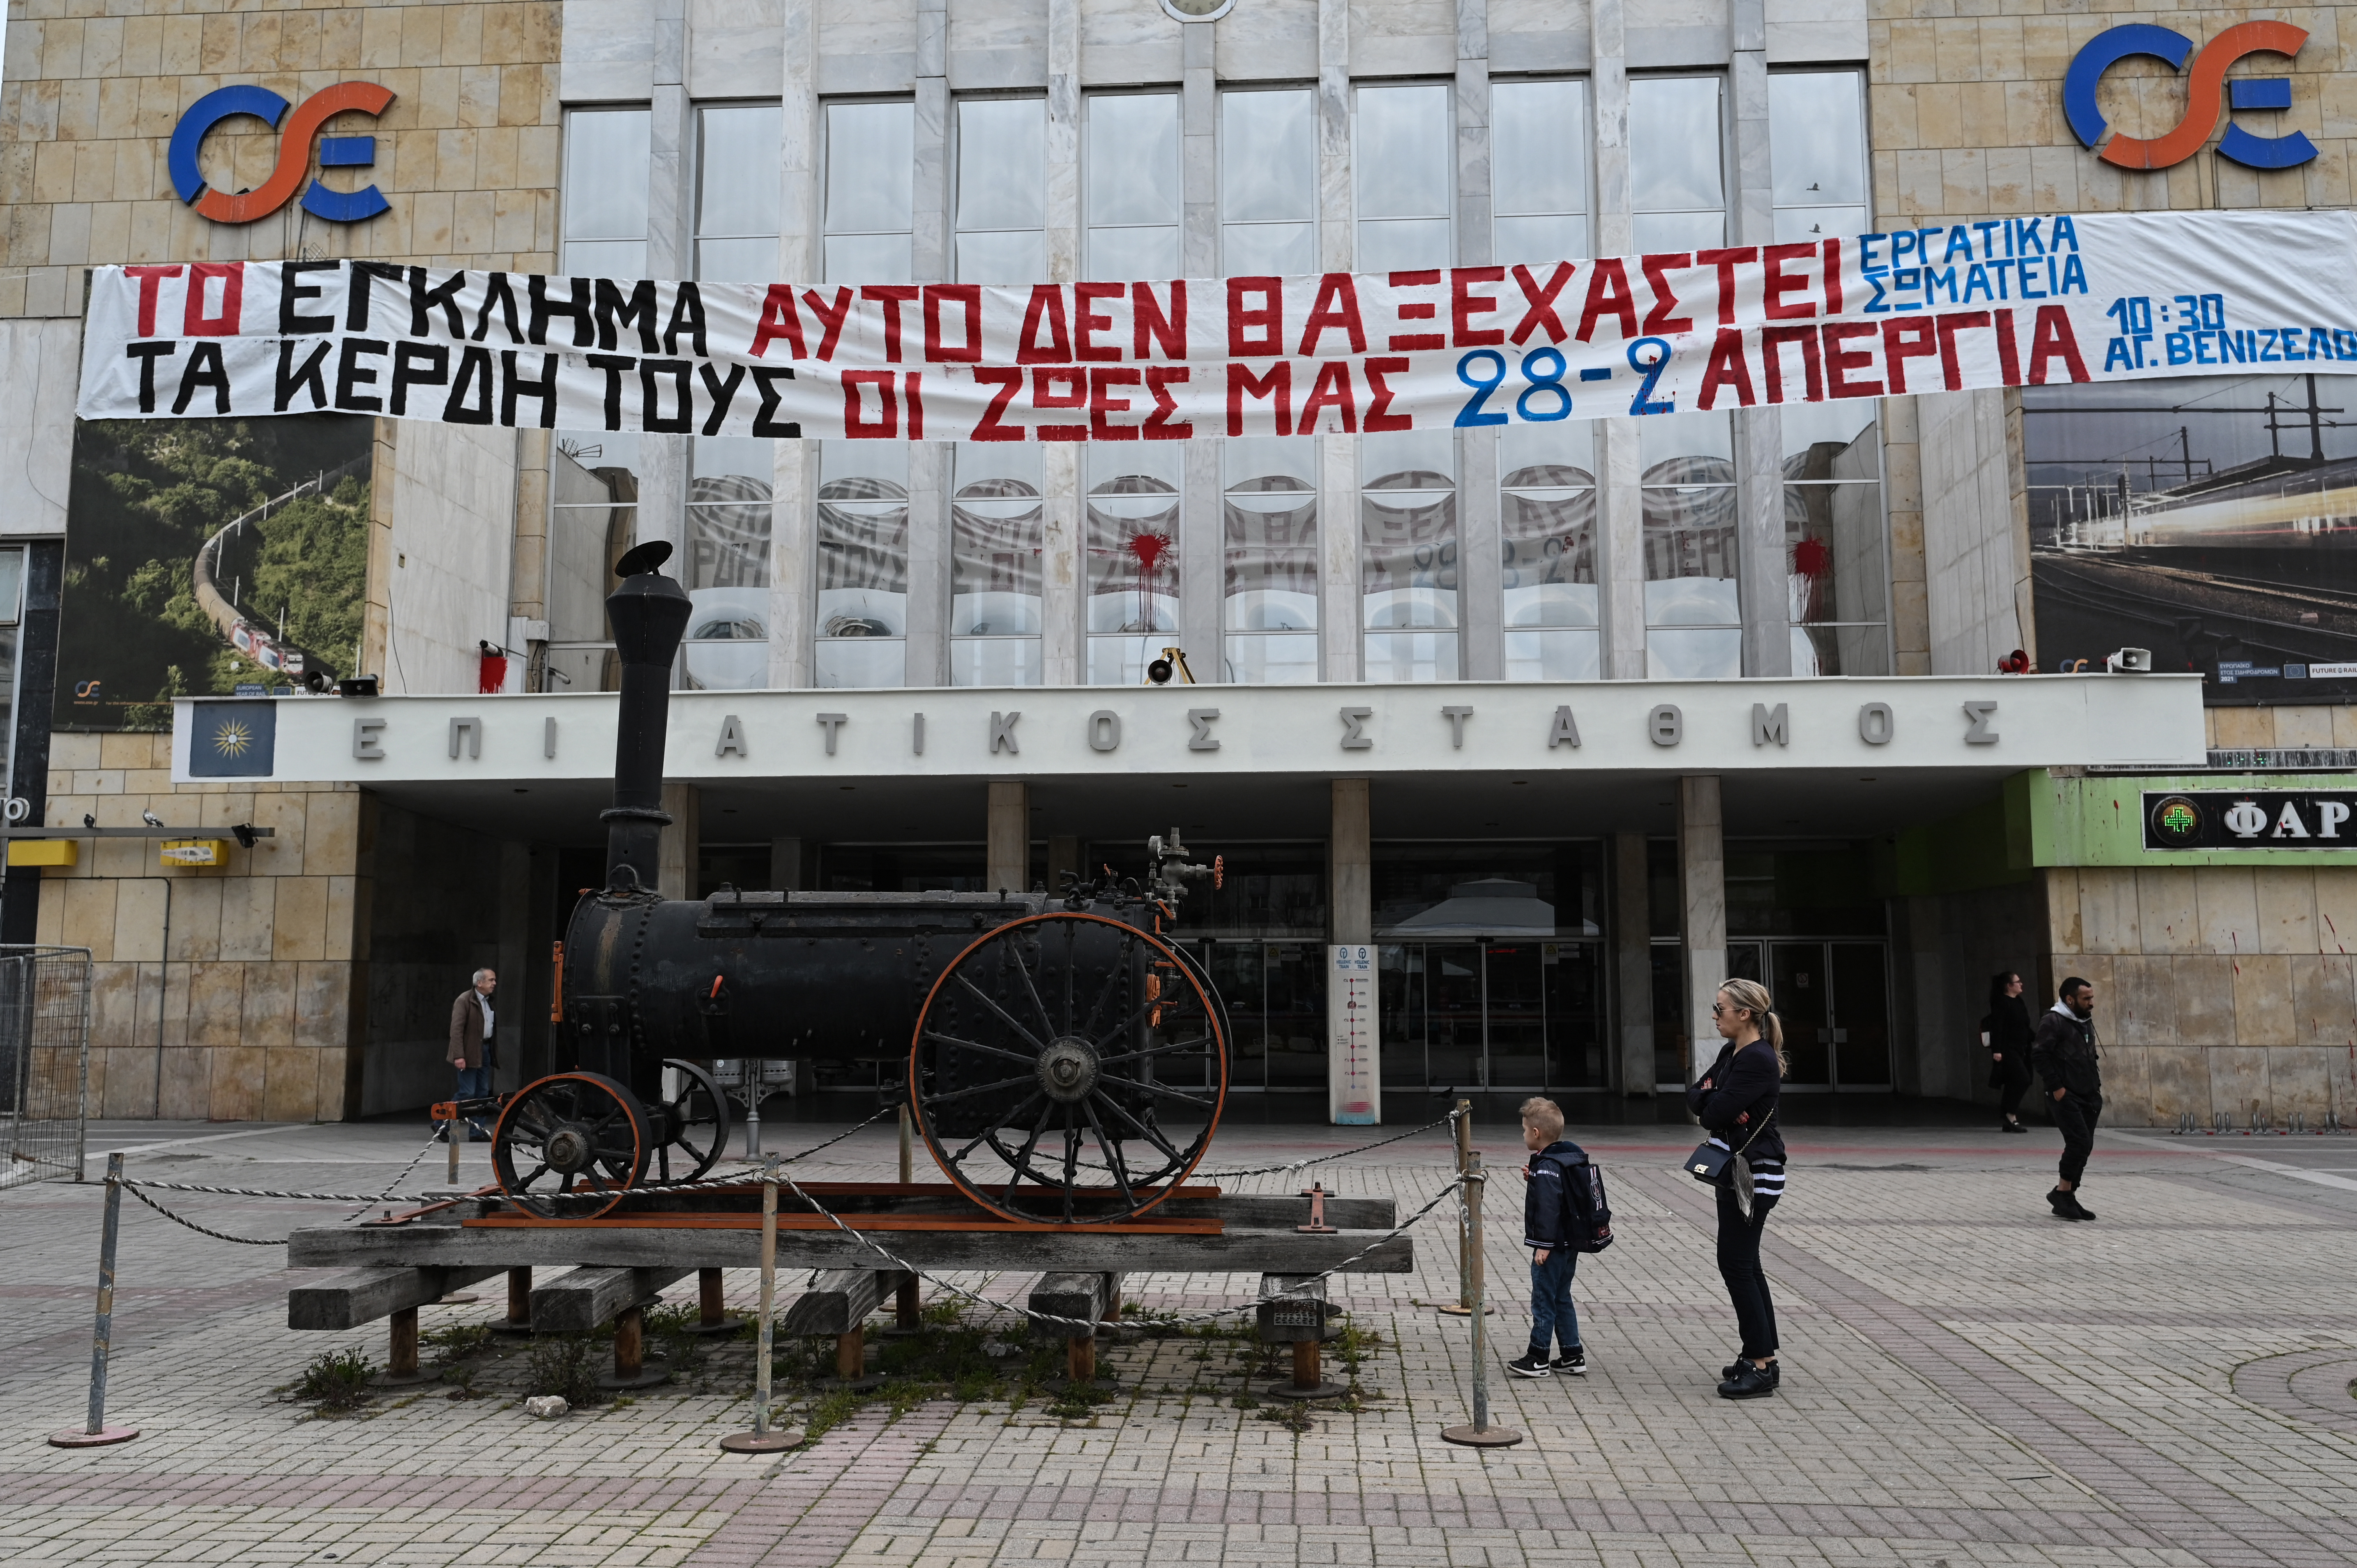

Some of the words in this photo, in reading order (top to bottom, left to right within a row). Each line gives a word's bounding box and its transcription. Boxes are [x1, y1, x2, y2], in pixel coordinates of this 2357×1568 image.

[1859, 215, 2080, 274] ΕΡΓΑΤΙΚΑ
[124, 259, 246, 337] ΤΟ
[278, 259, 709, 357] ΕΓΚΛΗΜΑ
[748, 283, 982, 363] ΑΥΤΟ
[1015, 279, 1187, 364] ΔΕΝ
[1388, 237, 1843, 352] ΞΕΧΑΣΤΕΙ
[1863, 254, 2088, 313] ΣΩΜΑΤΕΙΑ
[2106, 293, 2226, 336] 10:30
[126, 340, 232, 415] ΤΑ
[273, 337, 558, 429] ΚΕΡΔΗ
[586, 353, 801, 438] ΤΟΥΣ
[841, 369, 924, 441] ΟΙ
[1226, 356, 1413, 436] ΜΑΣ
[1696, 305, 2092, 411] ΑΠΕΡΓΙΑ
[2166, 327, 2357, 367] ΒΕΝΙΖΕΛΟ
[353, 708, 1220, 759] ΕΠΙΑΤΙΚΟΣ
[1340, 701, 2000, 749] ΣΤΑΘΜΟΣ
[2224, 801, 2357, 838] ΦΑΡ
